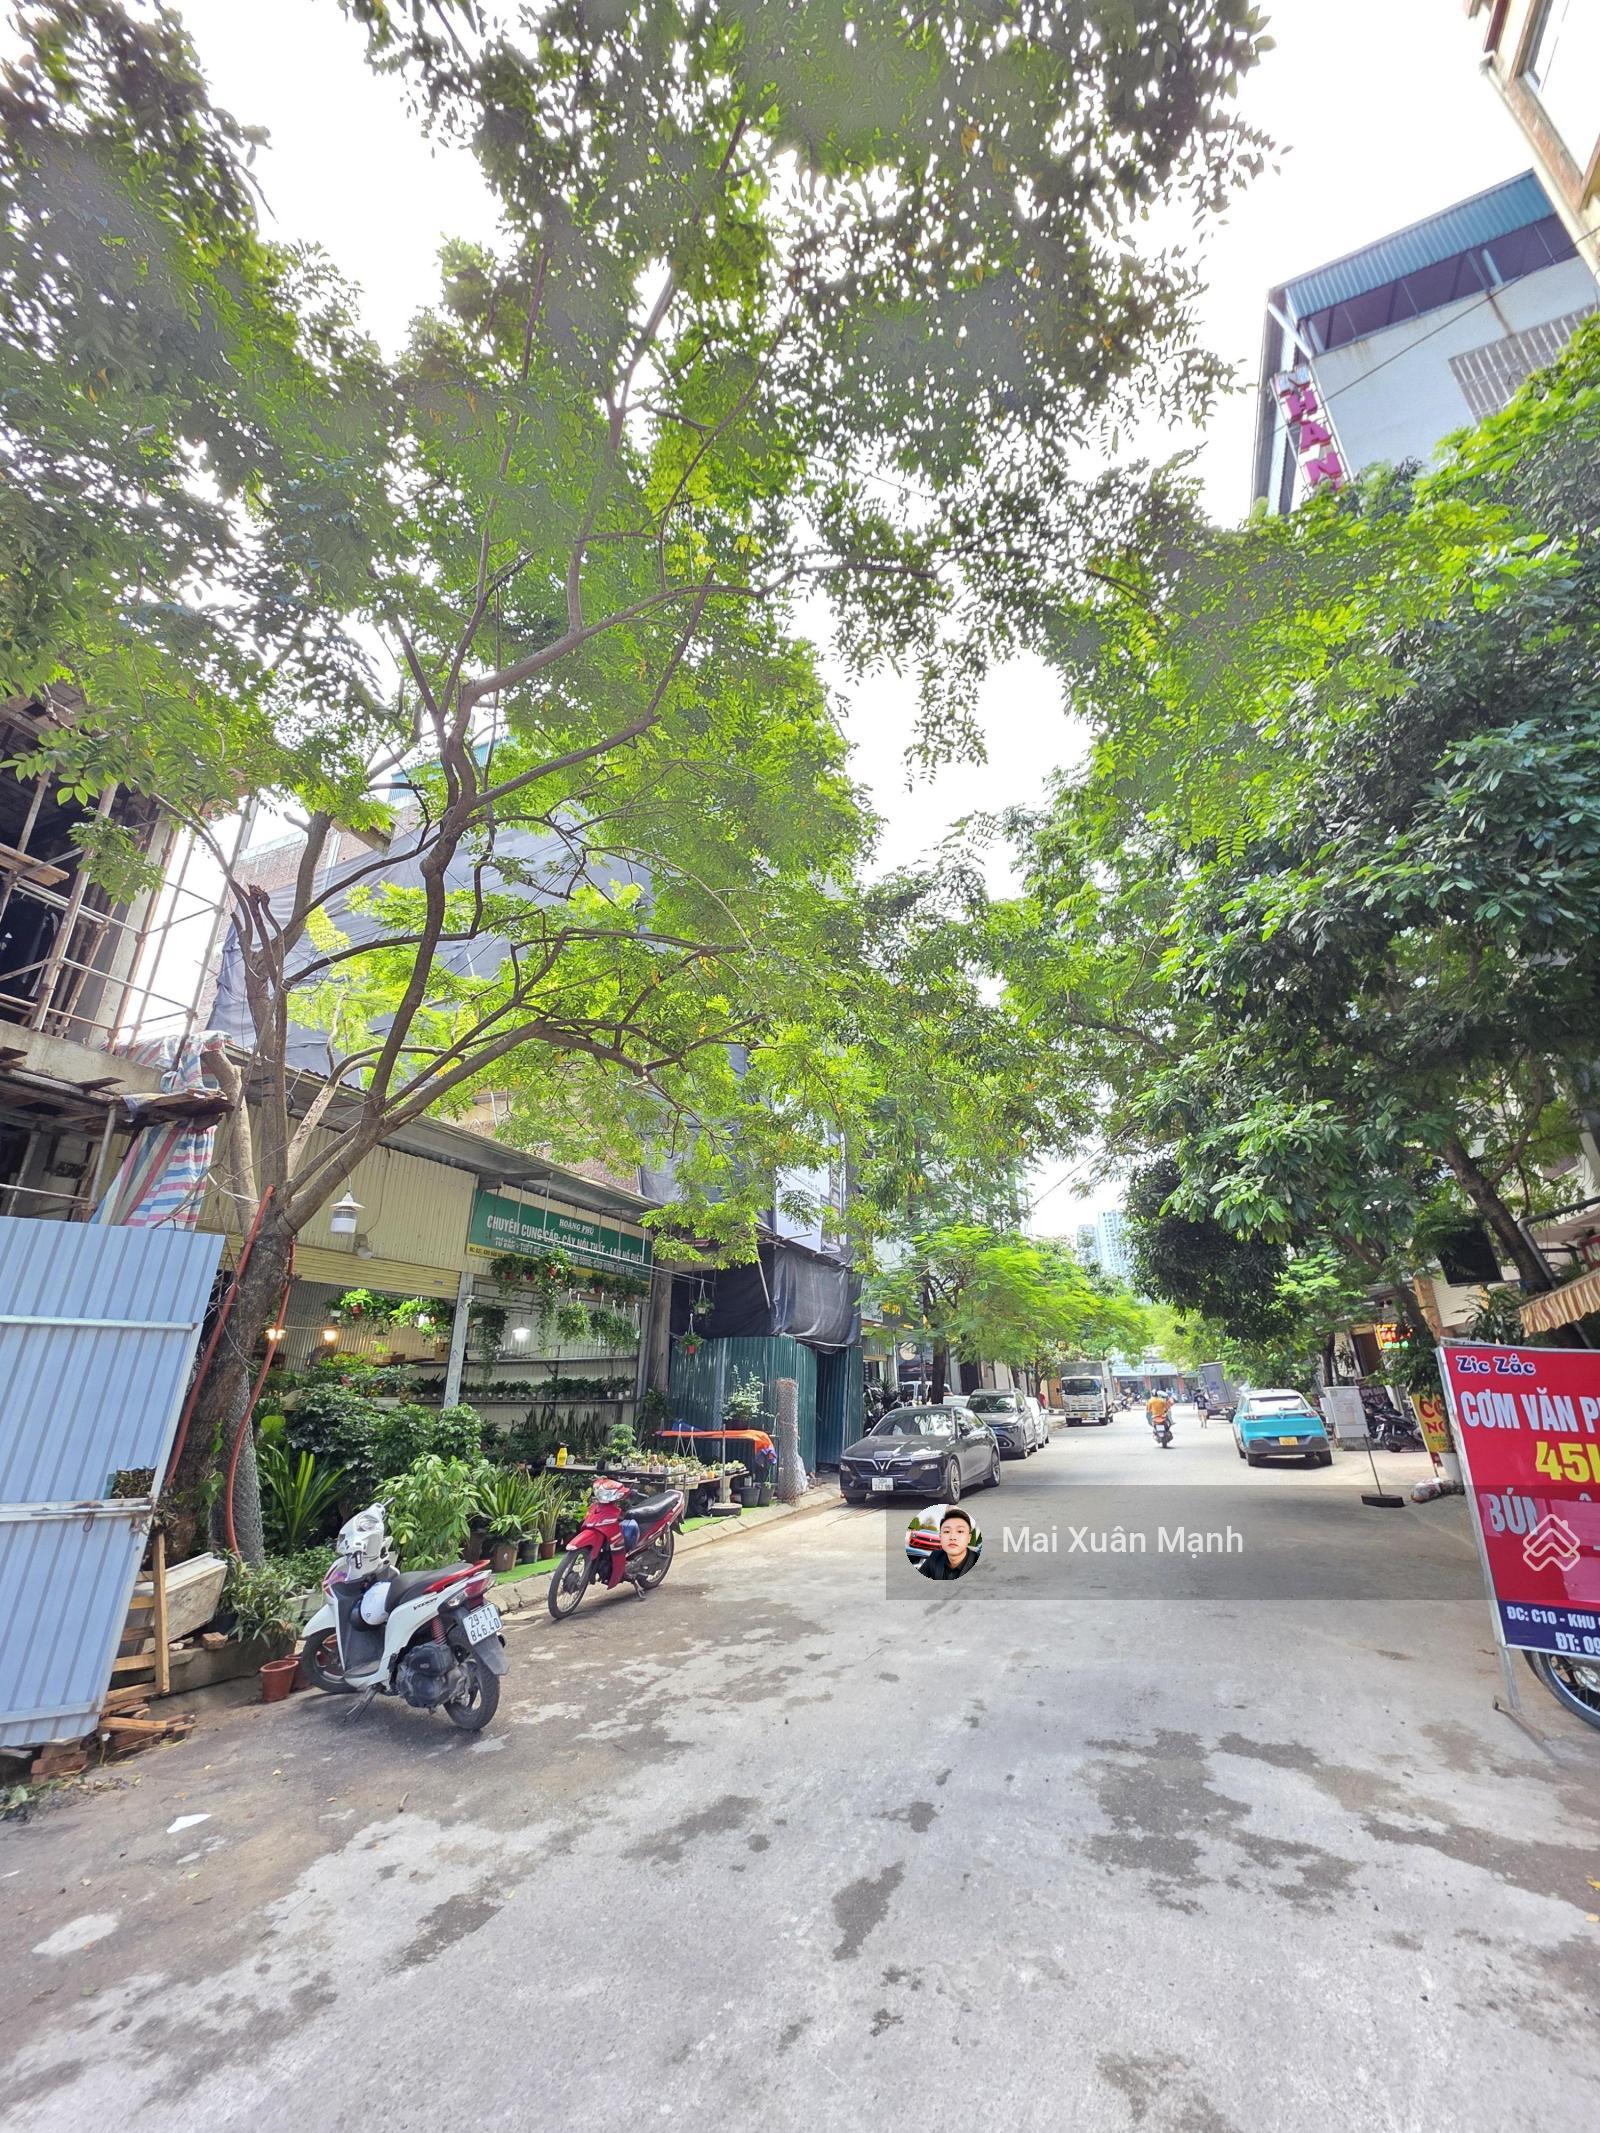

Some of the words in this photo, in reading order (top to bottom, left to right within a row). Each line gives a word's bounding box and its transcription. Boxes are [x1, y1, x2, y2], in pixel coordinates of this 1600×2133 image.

[487, 1215, 520, 1236] CHUYÊN
[521, 1224, 543, 1241] CUNG
[1456, 1355, 1491, 1374] Zic
[1494, 1353, 1536, 1375] Zắc
[1460, 1388, 1520, 1430] CƠM
[1520, 1387, 1579, 1433] VĂN
[1579, 1396, 1600, 1434] P
[469, 1607, 494, 1628] 29-T1
[470, 1617, 500, 1642] 846.40
[1506, 1606, 1530, 1622] ĐC:
[1531, 1609, 1557, 1625] C10
[1567, 1613, 1596, 1630] KHU
[1555, 1631, 1582, 1651] ĐT:
